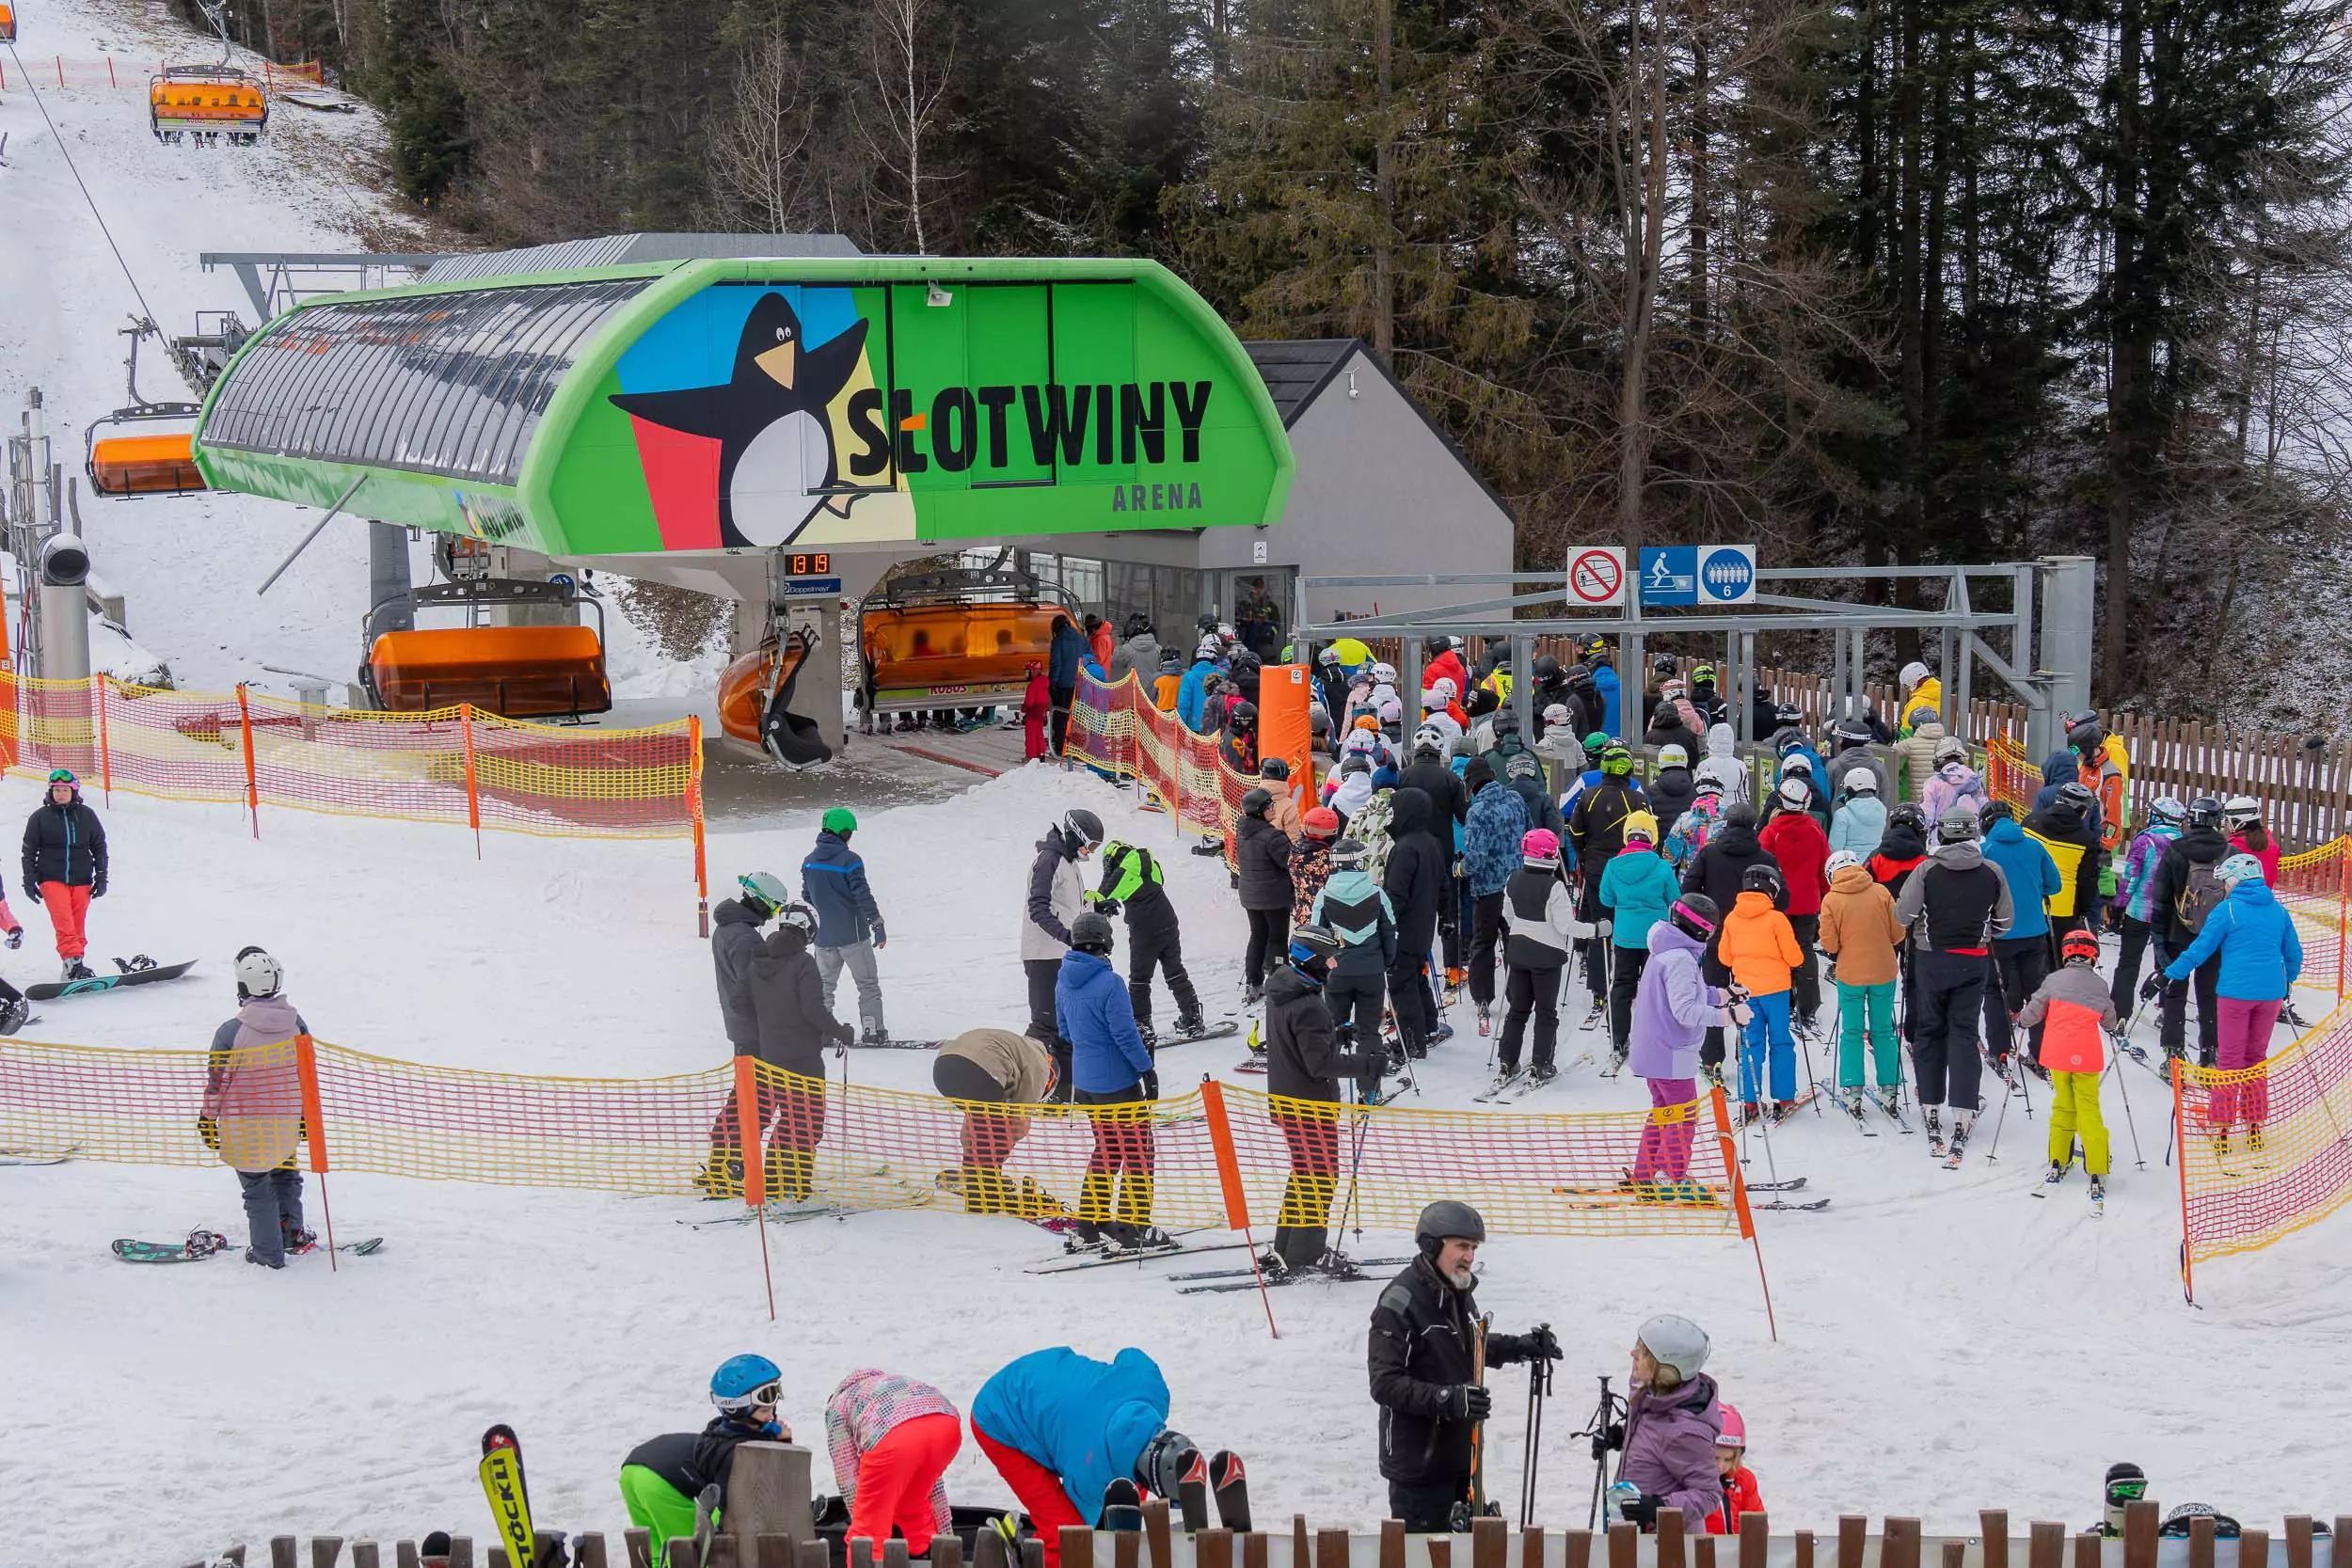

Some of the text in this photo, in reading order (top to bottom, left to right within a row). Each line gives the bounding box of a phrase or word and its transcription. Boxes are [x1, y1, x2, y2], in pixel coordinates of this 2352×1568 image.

[847, 380, 1213, 477] SŁOTWINY
[1112, 482, 1202, 513] ARENA
[793, 554, 828, 574] 13 19
[790, 585, 829, 594] Doppelmayr
[1723, 585, 1732, 597] 6
